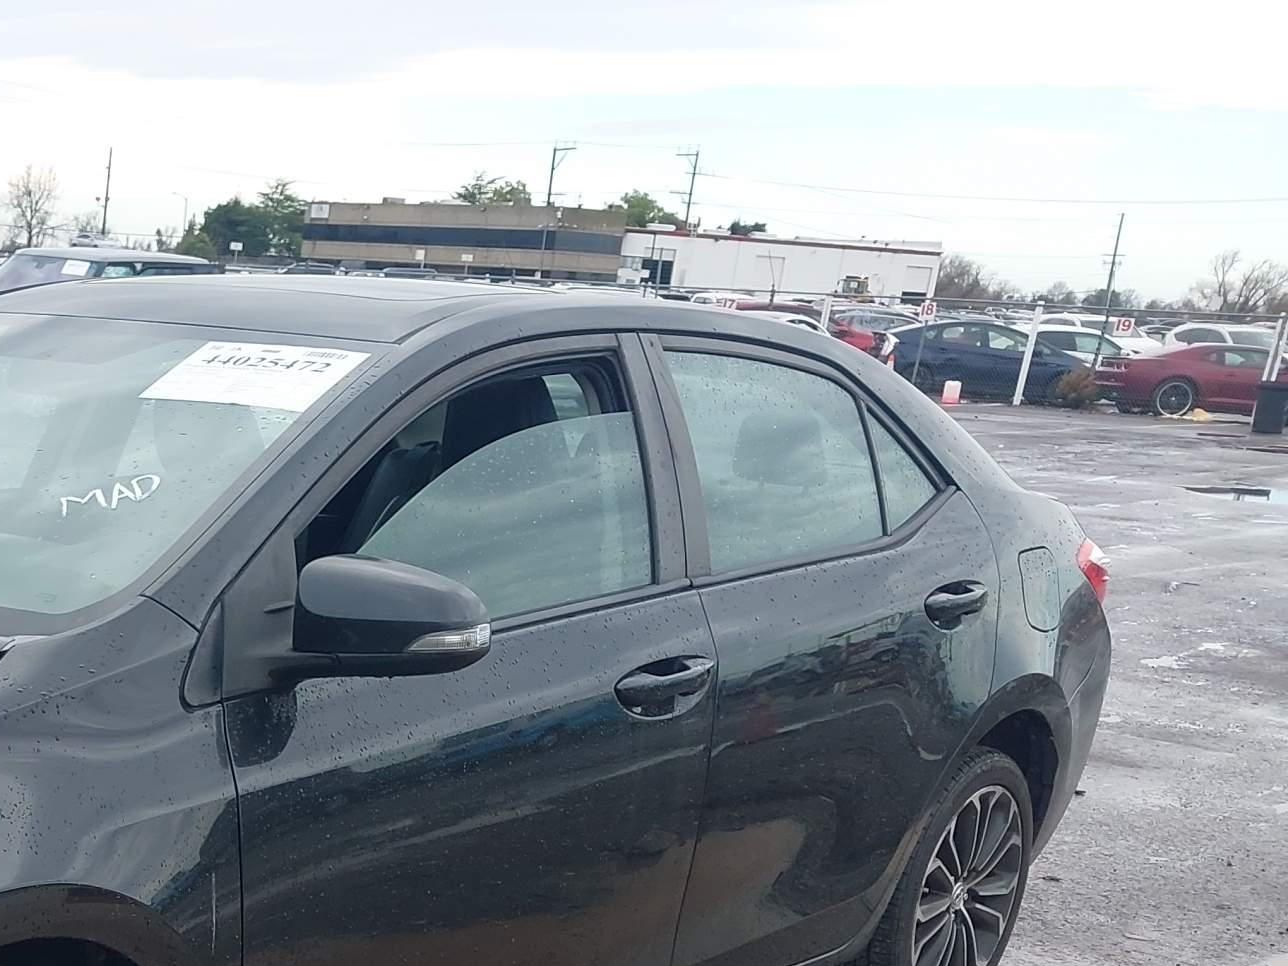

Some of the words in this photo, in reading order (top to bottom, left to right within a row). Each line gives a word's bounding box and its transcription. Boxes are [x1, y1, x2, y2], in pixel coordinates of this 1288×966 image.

[921, 303, 934, 316] 18
[1115, 319, 1132, 332] 19
[201, 354, 333, 373] 44025472
[60, 474, 162, 517] MAD
